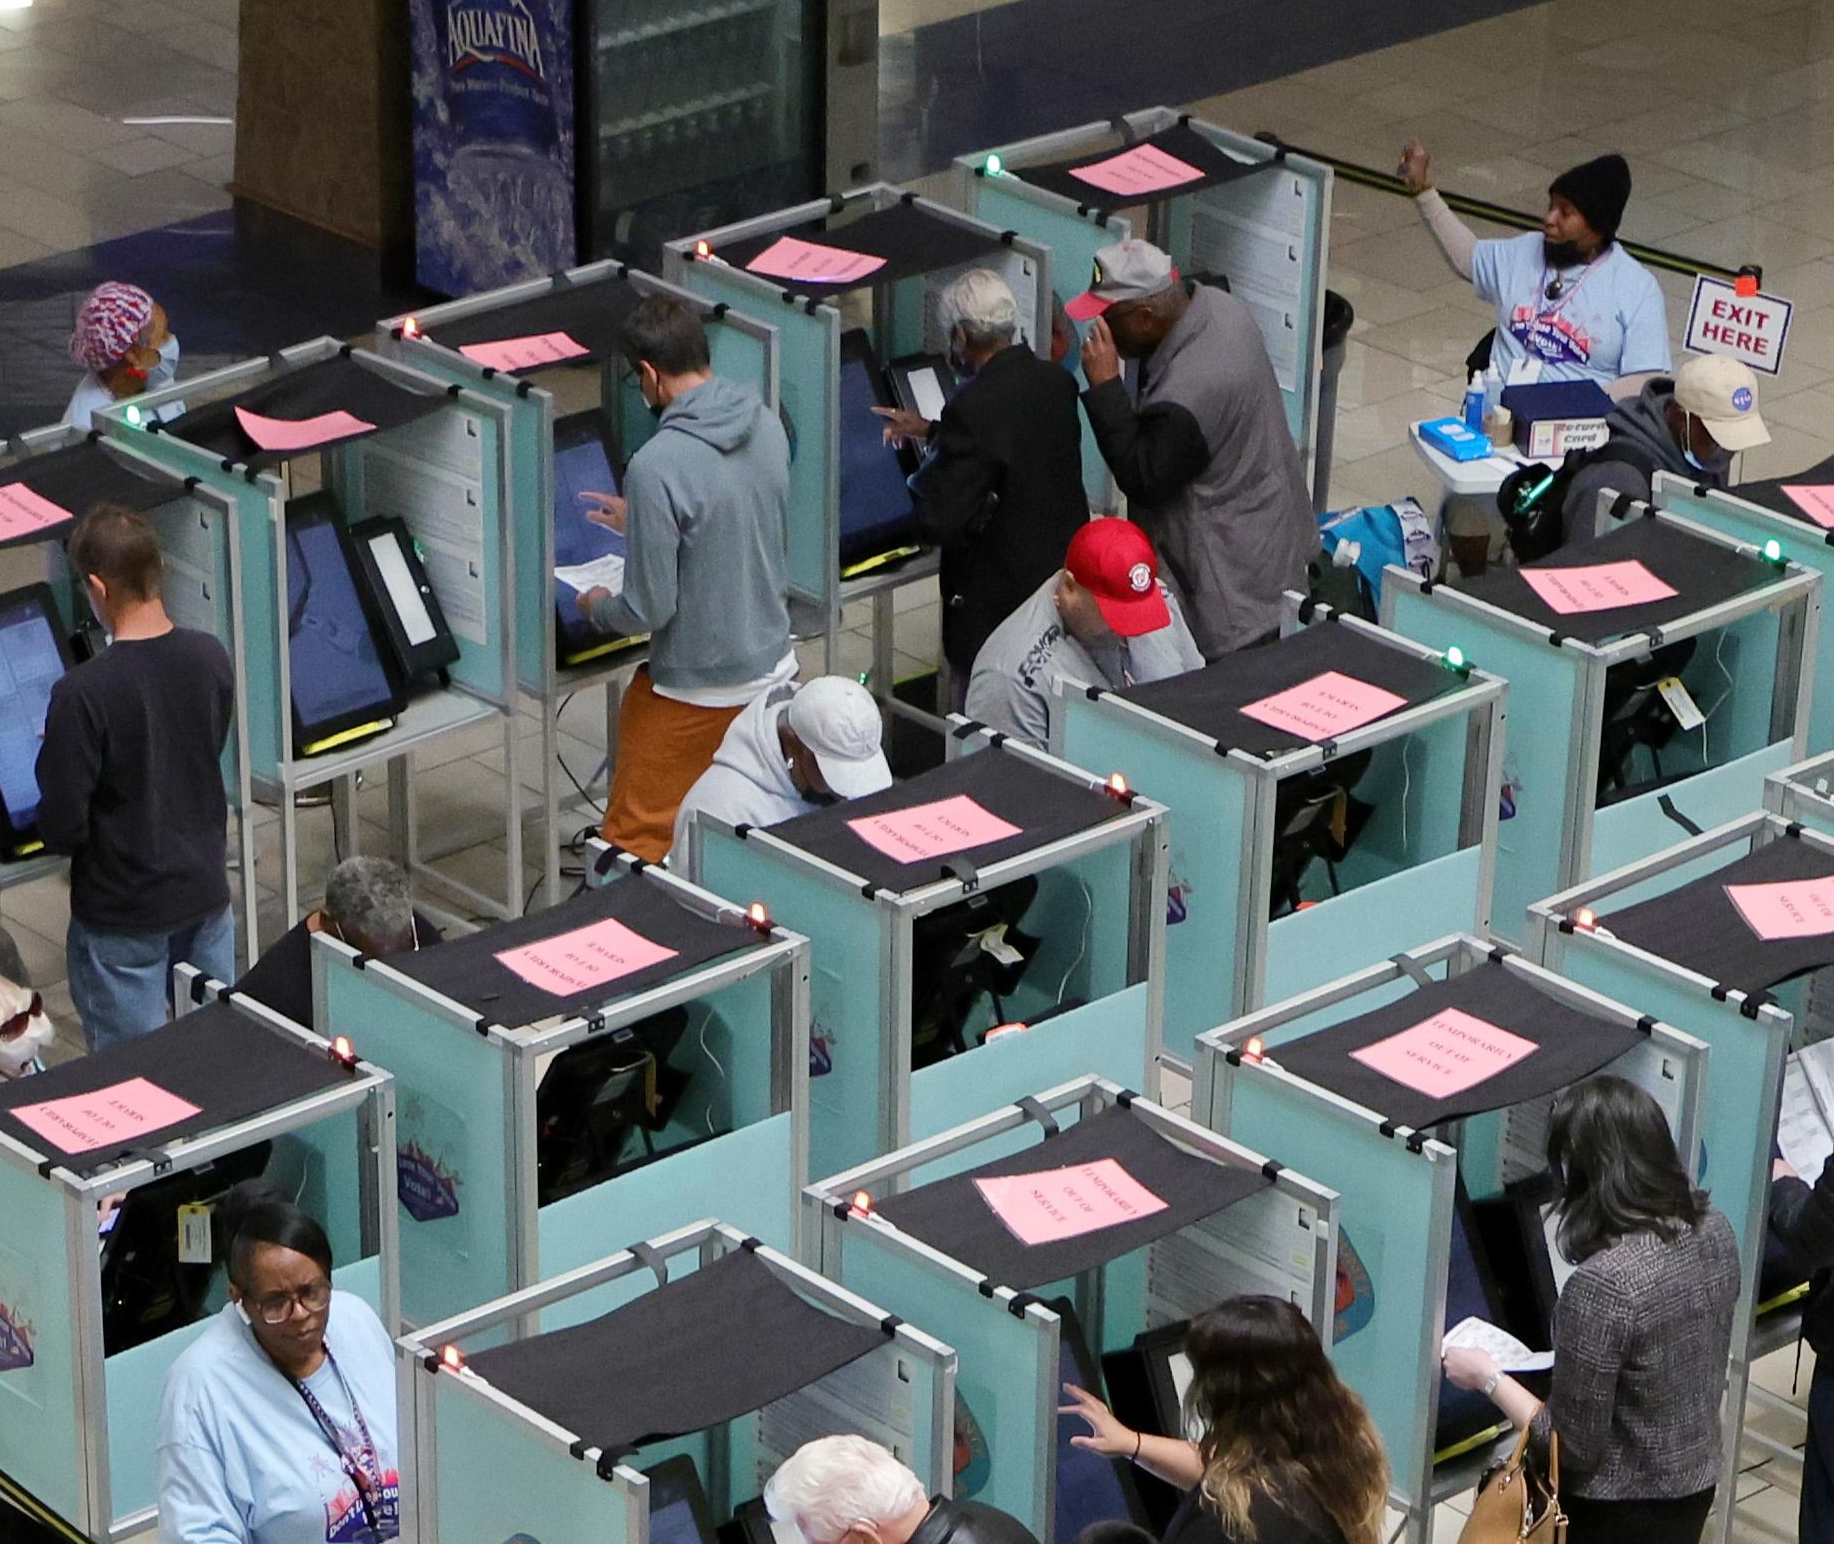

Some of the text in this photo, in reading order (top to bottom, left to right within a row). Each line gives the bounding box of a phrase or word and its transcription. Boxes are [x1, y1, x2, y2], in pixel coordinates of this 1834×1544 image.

[447, 8, 544, 79] AQUAFINA
[1712, 299, 1770, 330] EXIT
[1702, 321, 1769, 356] HERE
